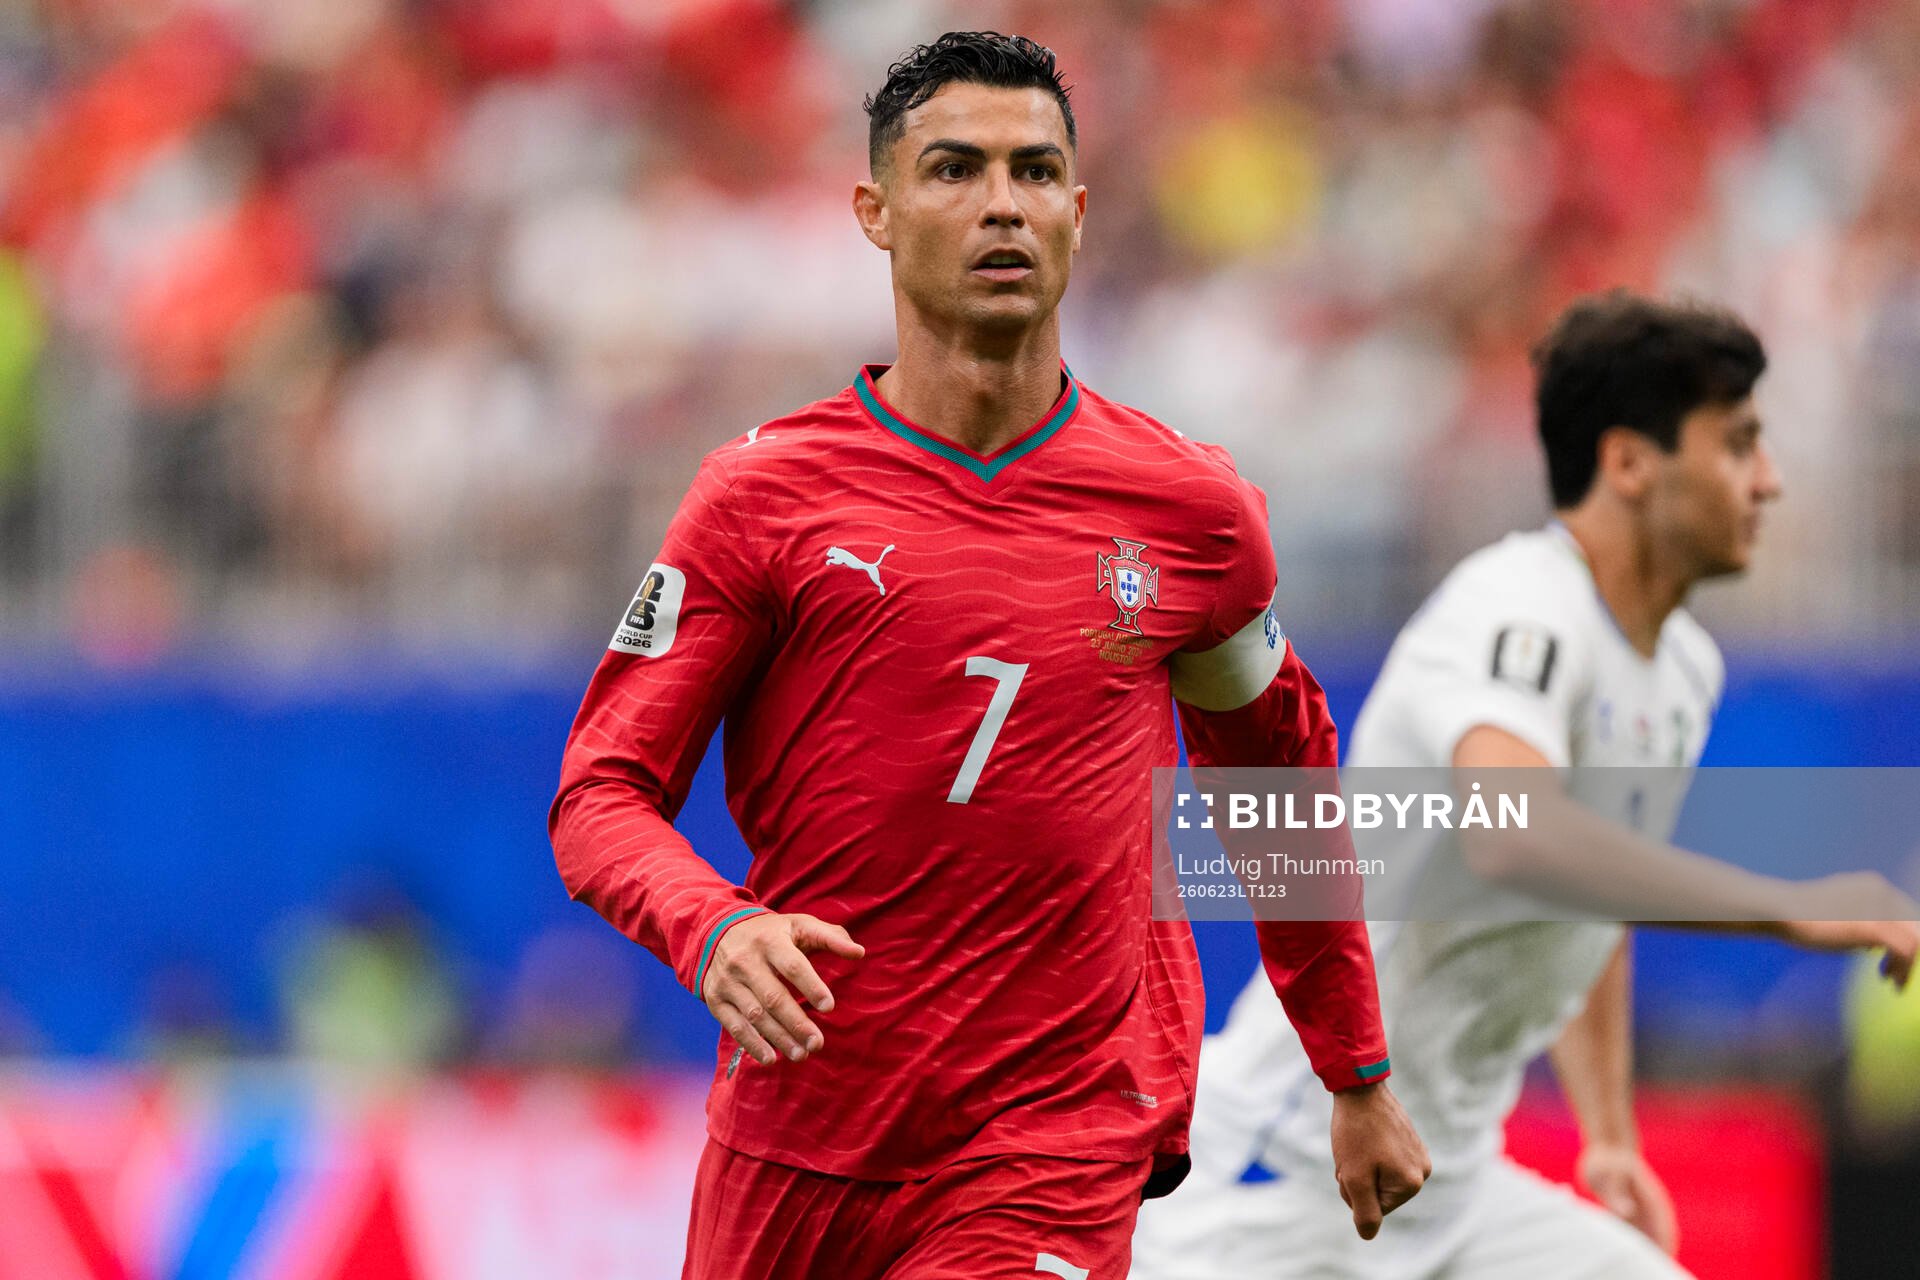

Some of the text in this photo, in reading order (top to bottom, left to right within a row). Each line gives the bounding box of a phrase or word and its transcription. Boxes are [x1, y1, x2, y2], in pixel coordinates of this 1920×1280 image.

[630, 615, 645, 626] FIFA
[616, 634, 652, 649] 2026
[1099, 650, 1133, 666] HOUSTON
[946, 656, 1030, 804] 7
